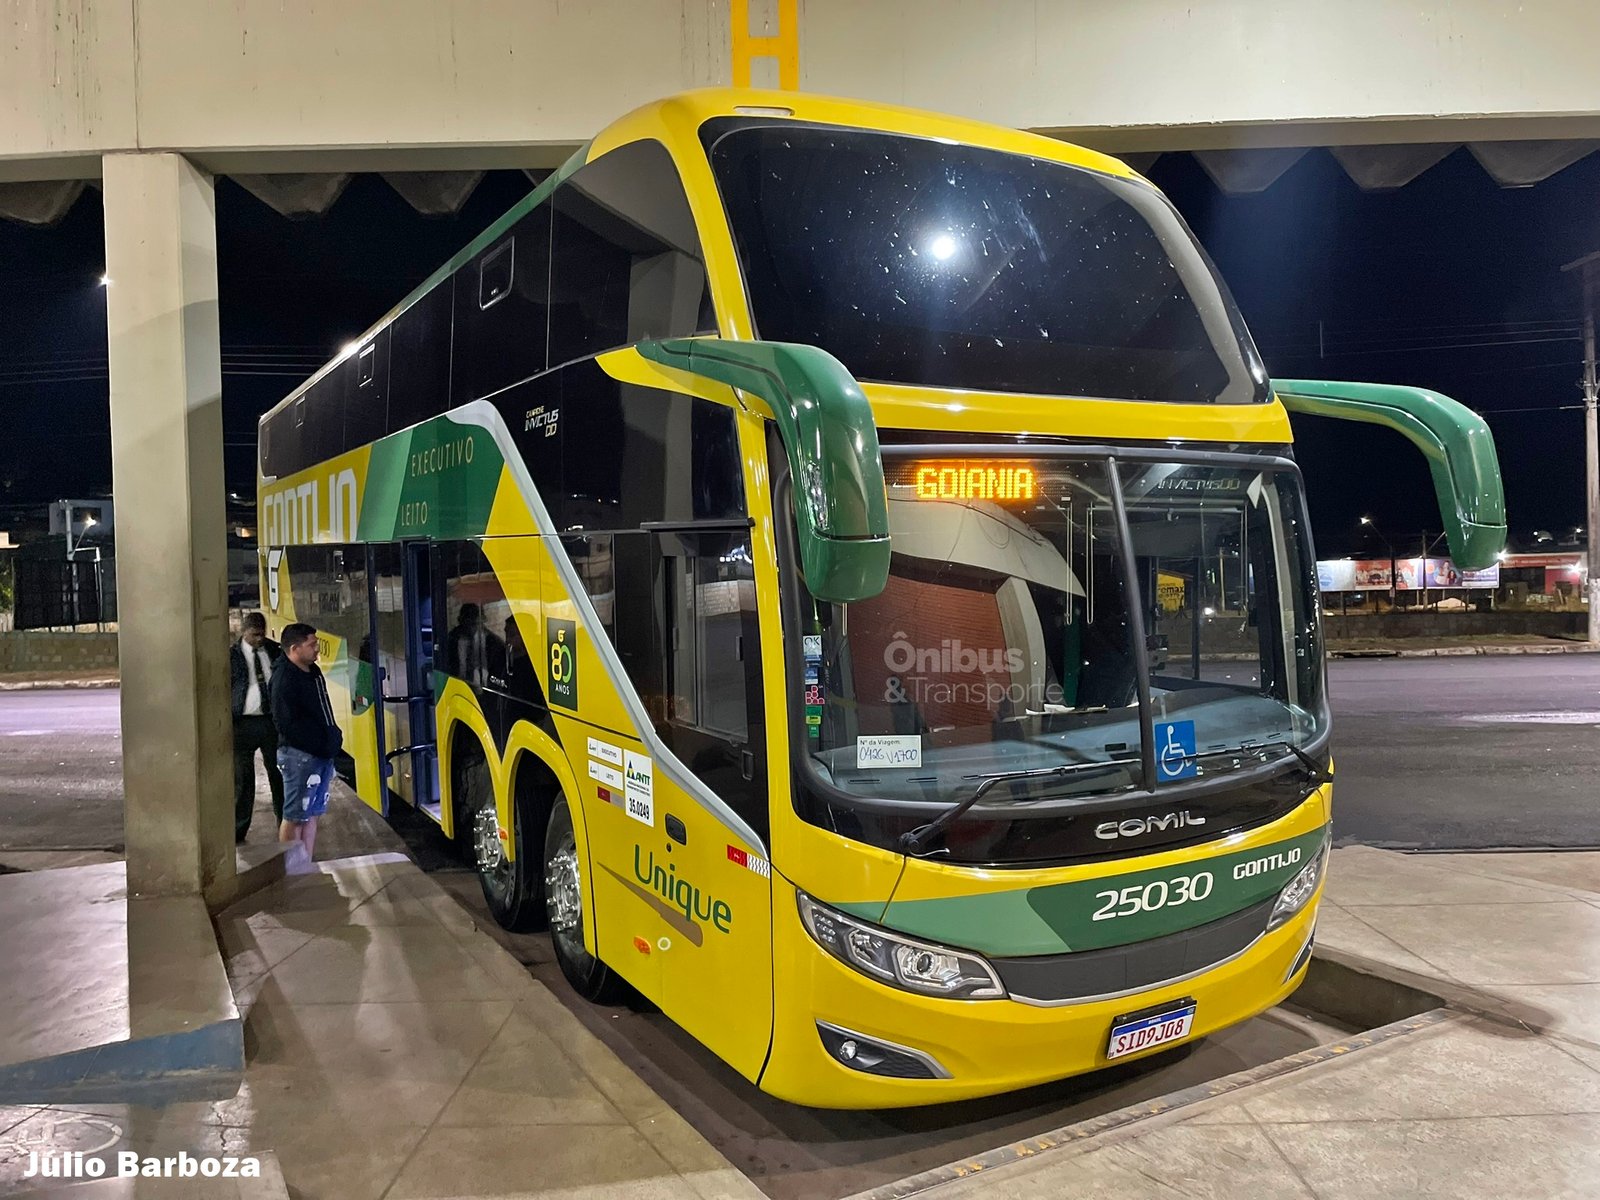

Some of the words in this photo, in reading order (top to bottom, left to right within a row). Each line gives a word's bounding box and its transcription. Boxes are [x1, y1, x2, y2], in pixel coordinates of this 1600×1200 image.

[411, 435, 474, 477] EXECUTIVO
[916, 467, 1034, 499] GOIANIA
[263, 467, 357, 547] GONTIJO
[401, 501, 428, 526] LEITO
[551, 643, 572, 683] 80
[555, 683, 570, 695] ANOS
[628, 797, 650, 820] 35.0249
[1094, 810, 1206, 840] COMIL
[634, 844, 732, 934] Unique
[1092, 871, 1214, 922] 25030
[1232, 847, 1301, 880] GONTIJO
